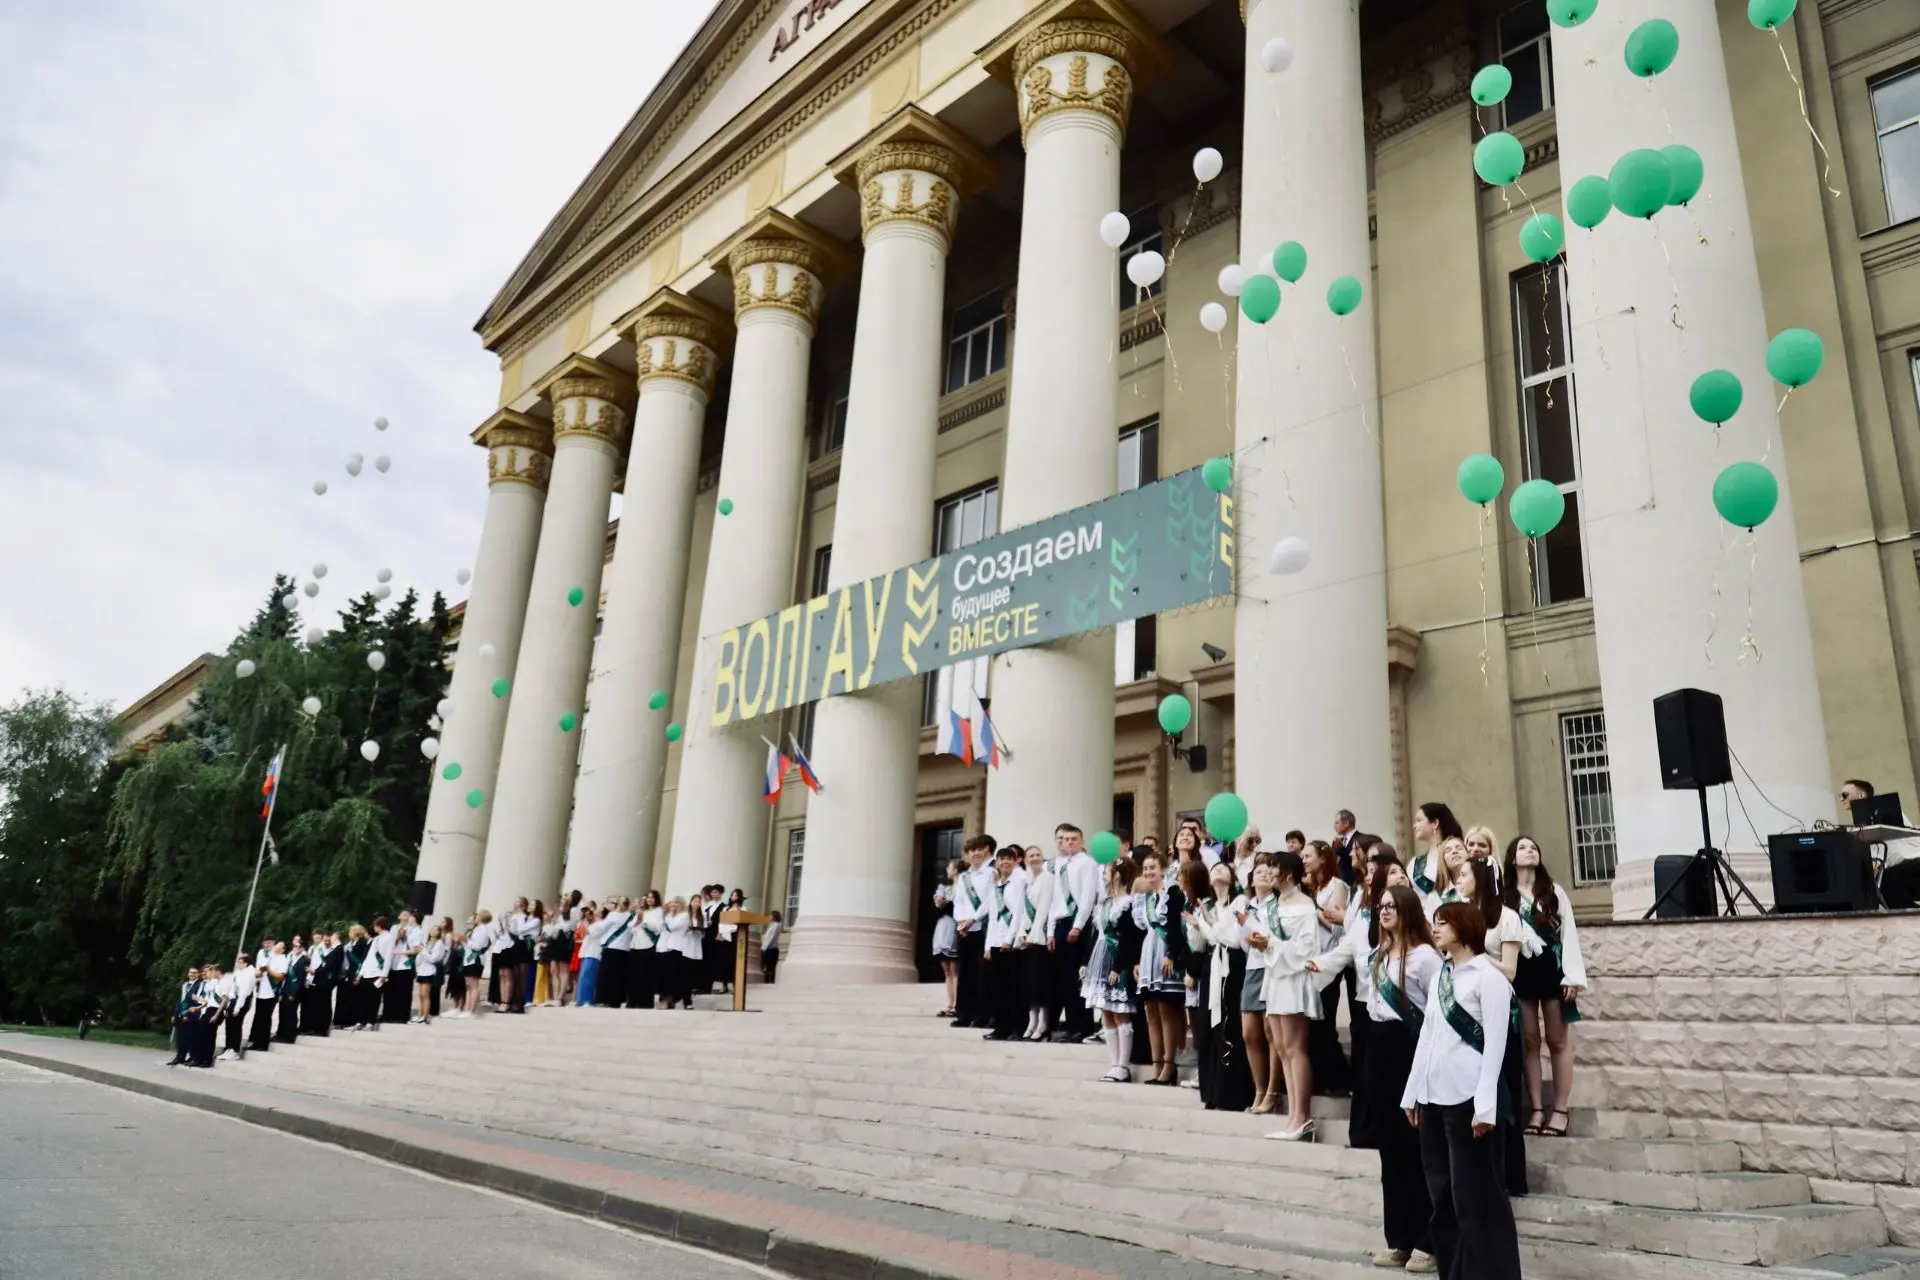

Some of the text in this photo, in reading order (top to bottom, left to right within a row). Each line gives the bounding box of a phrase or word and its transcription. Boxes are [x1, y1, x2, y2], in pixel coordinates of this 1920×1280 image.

[768, 0, 842, 62] АГР
[954, 521, 1103, 591] Создаем
[949, 603, 1040, 656] ВМЕСТЕ
[952, 585, 1011, 622] будущее
[711, 572, 894, 727] ВОЛГАУ
